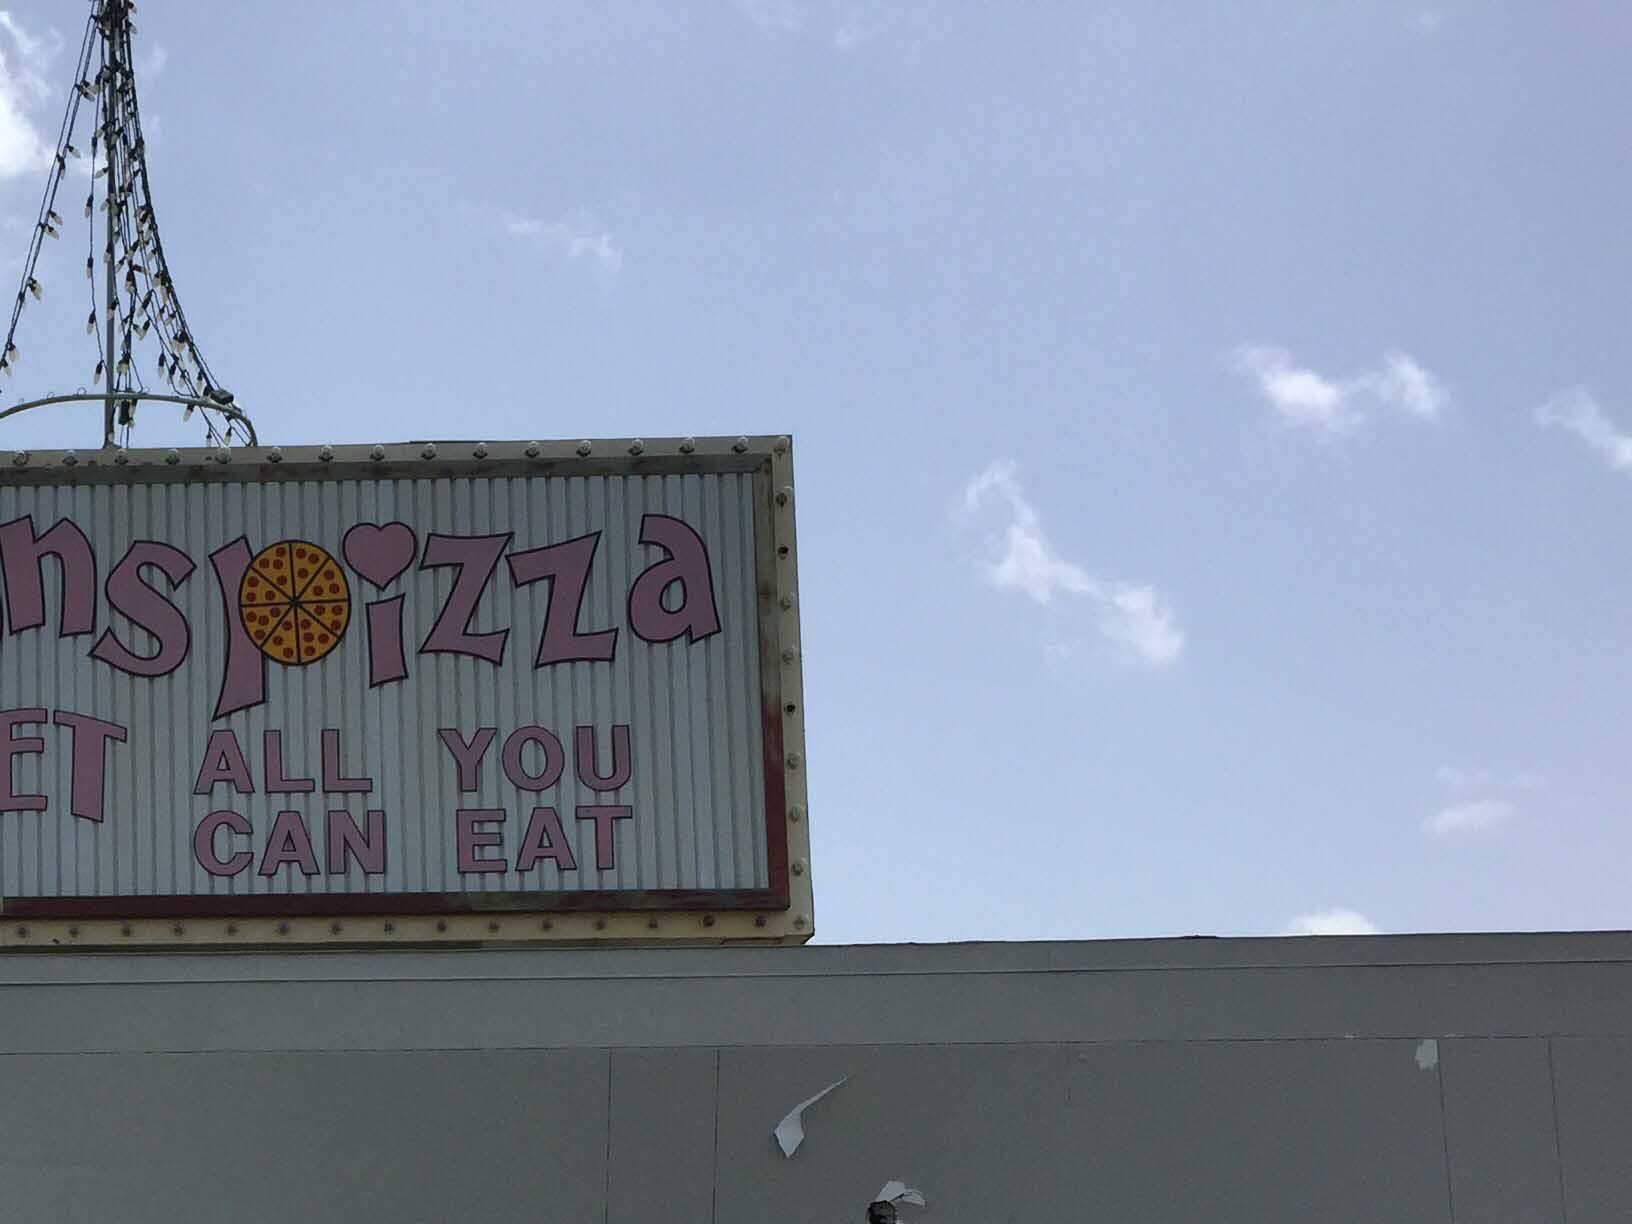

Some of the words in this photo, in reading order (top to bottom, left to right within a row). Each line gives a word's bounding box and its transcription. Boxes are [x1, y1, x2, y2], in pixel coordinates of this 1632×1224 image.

[209, 513, 721, 721] pizza
[194, 729, 373, 795] ALL
[438, 724, 632, 791] YOU
[193, 809, 386, 876] CAN
[456, 805, 632, 873] EAT
